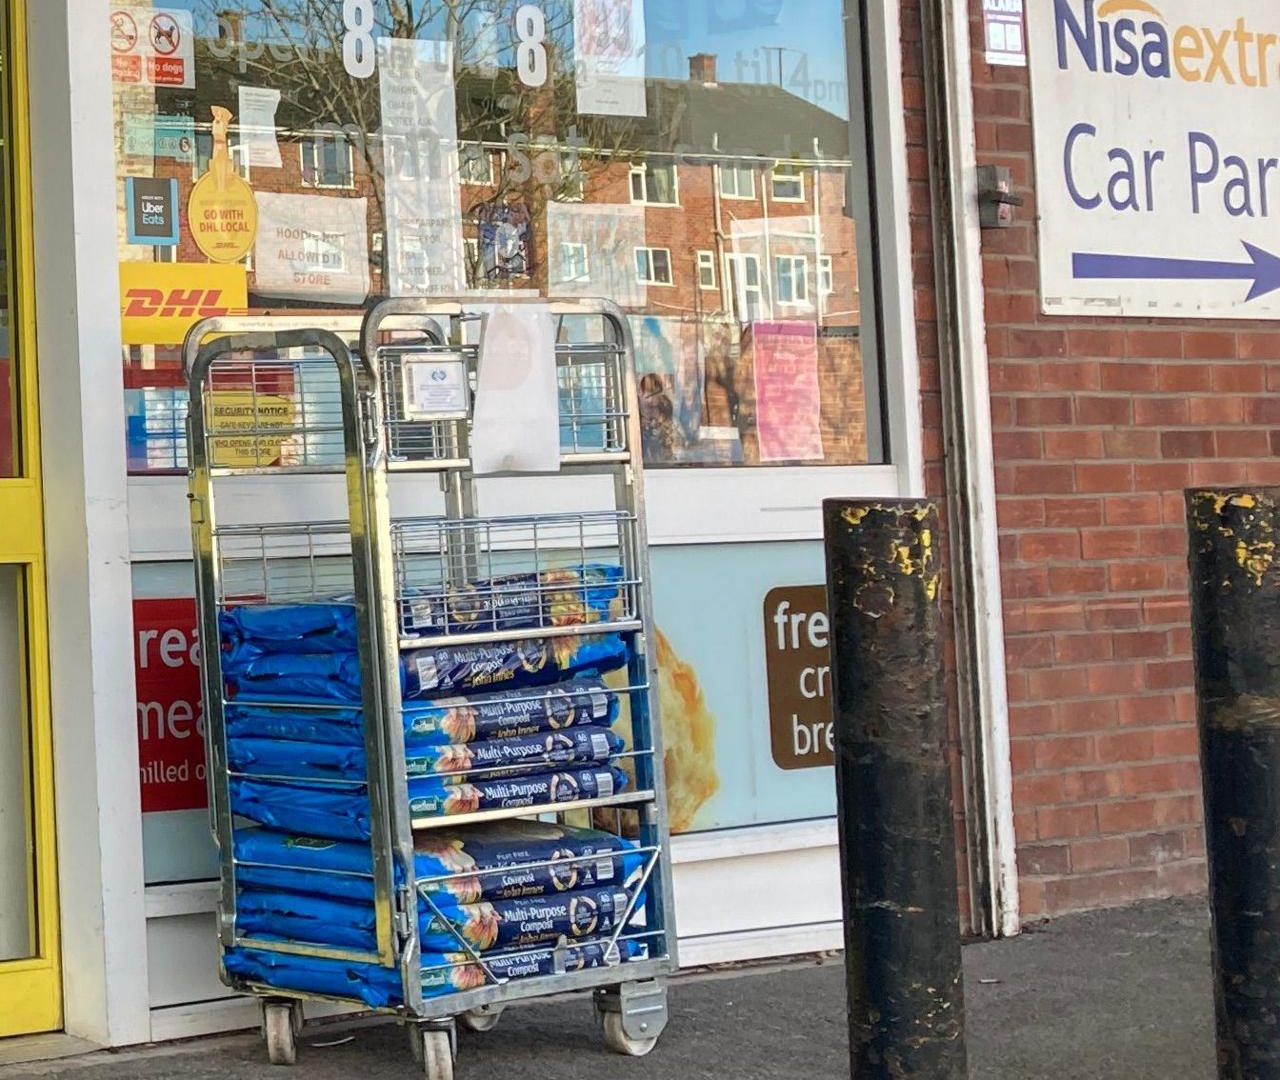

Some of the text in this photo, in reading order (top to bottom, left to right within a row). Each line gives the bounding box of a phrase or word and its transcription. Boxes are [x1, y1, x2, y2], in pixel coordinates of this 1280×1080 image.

[515, 4, 548, 88] 8
[148, 62, 160, 72] No
[162, 62, 183, 74] dogs
[1063, 122, 1166, 213] Car
[141, 202, 164, 215] Uber
[203, 209, 244, 221] GO WITH
[142, 213, 165, 225] Eats
[200, 221, 250, 233] DHL LOCAL
[293, 272, 331, 286] STORE
[123, 288, 230, 318] DHL
[214, 406, 289, 417] SECURITY NOTICE
[479, 699, 543, 719] Multi-Purpose
[497, 713, 531, 727] Compost
[476, 743, 544, 761] Multi-Purpose
[484, 782, 548, 800] Multi-Purpose
[501, 796, 535, 808] Compost
[502, 873, 536, 886] Compost
[504, 904, 568, 923] Multi-Purpose
[520, 920, 555, 933] Compost
[507, 962, 540, 976] Compost
